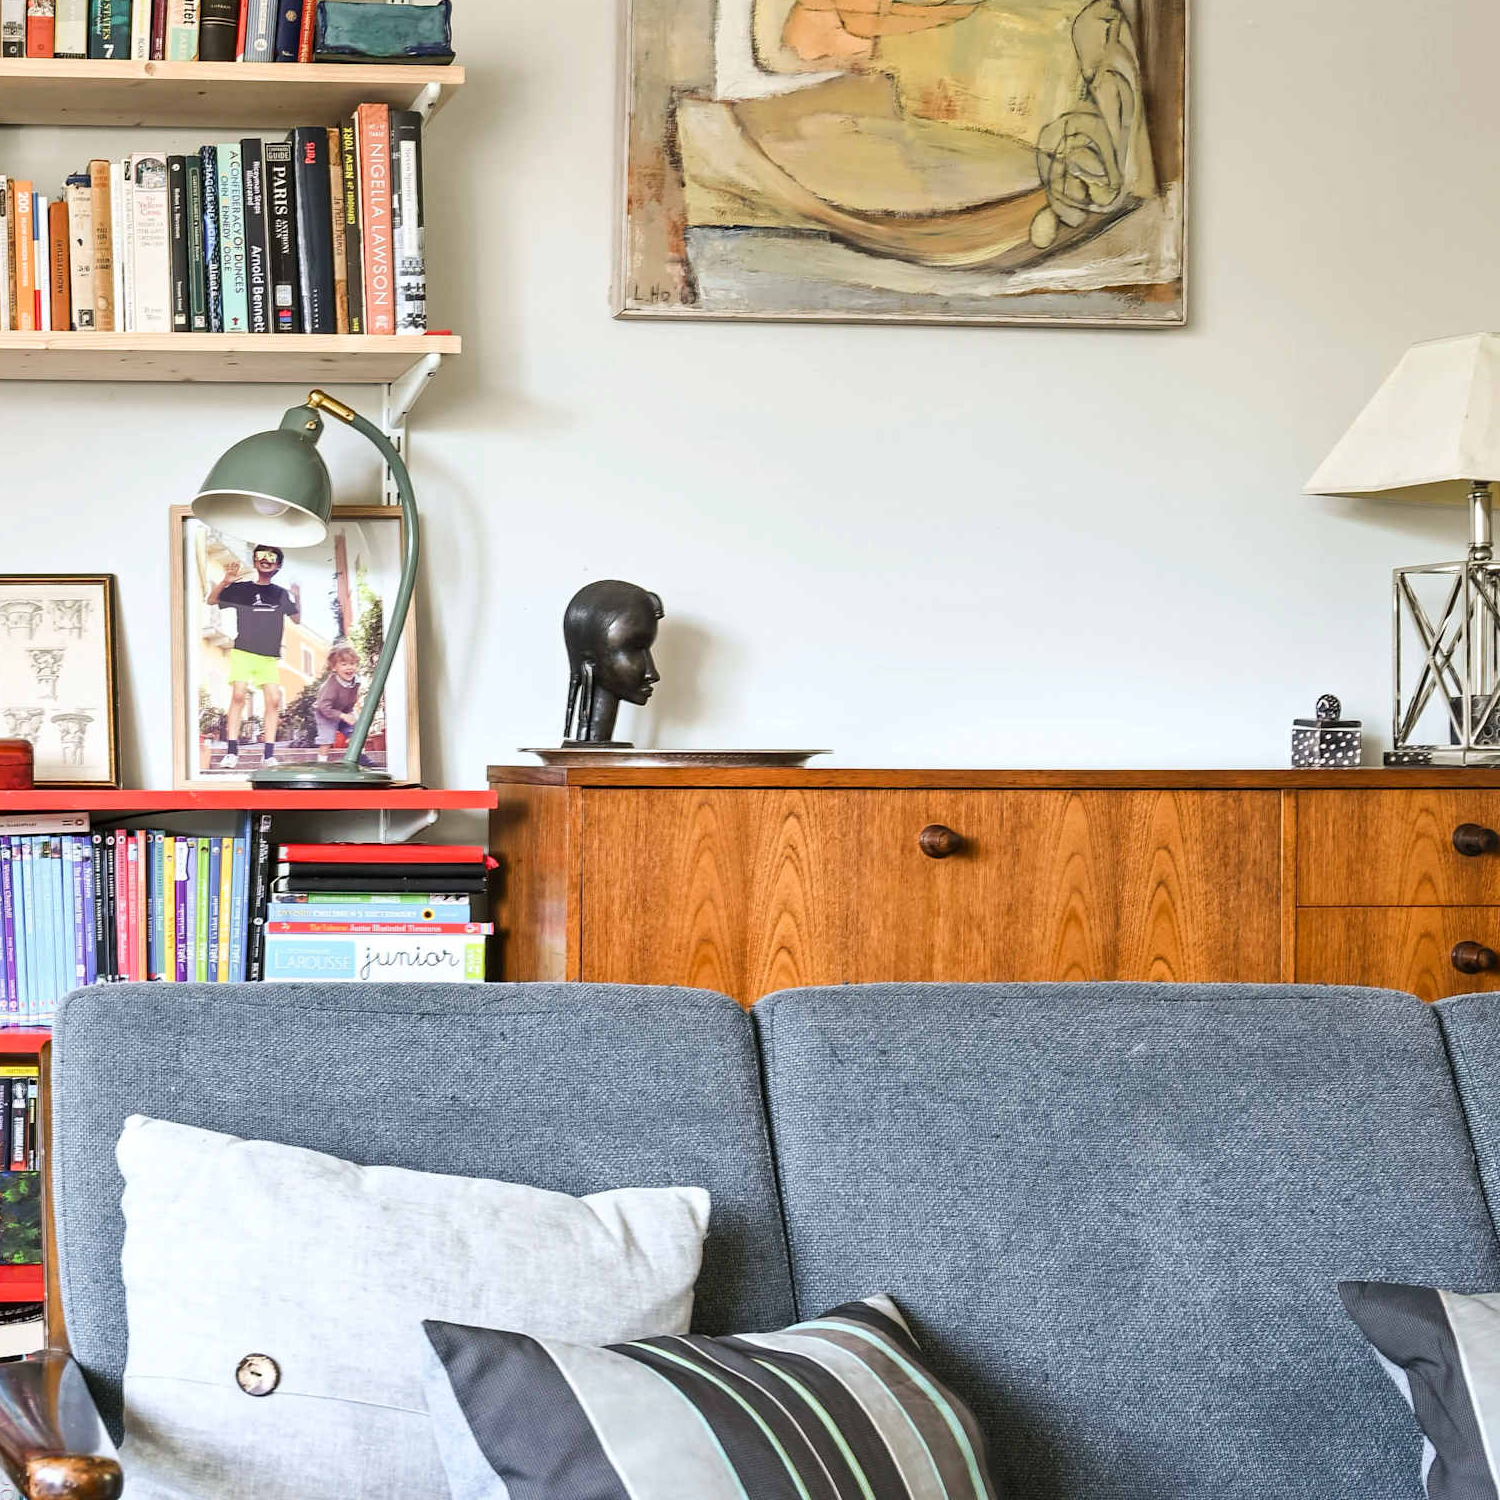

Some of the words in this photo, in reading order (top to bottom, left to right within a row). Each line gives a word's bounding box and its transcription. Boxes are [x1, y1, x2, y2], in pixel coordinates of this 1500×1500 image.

[103, 3, 111, 40] STATES
[230, 151, 238, 159] A
[304, 142, 316, 164] Paris
[230, 161, 242, 234] CONFEDERACY
[272, 166, 288, 215] PARIS
[370, 143, 387, 218] NIGELLA
[18, 191, 29, 213] 200
[234, 254, 244, 293] DUNCES
[250, 246, 263, 285] Arnold
[372, 225, 389, 305] LAWSON
[252, 287, 264, 332] Bennett
[359, 942, 460, 980] junior
